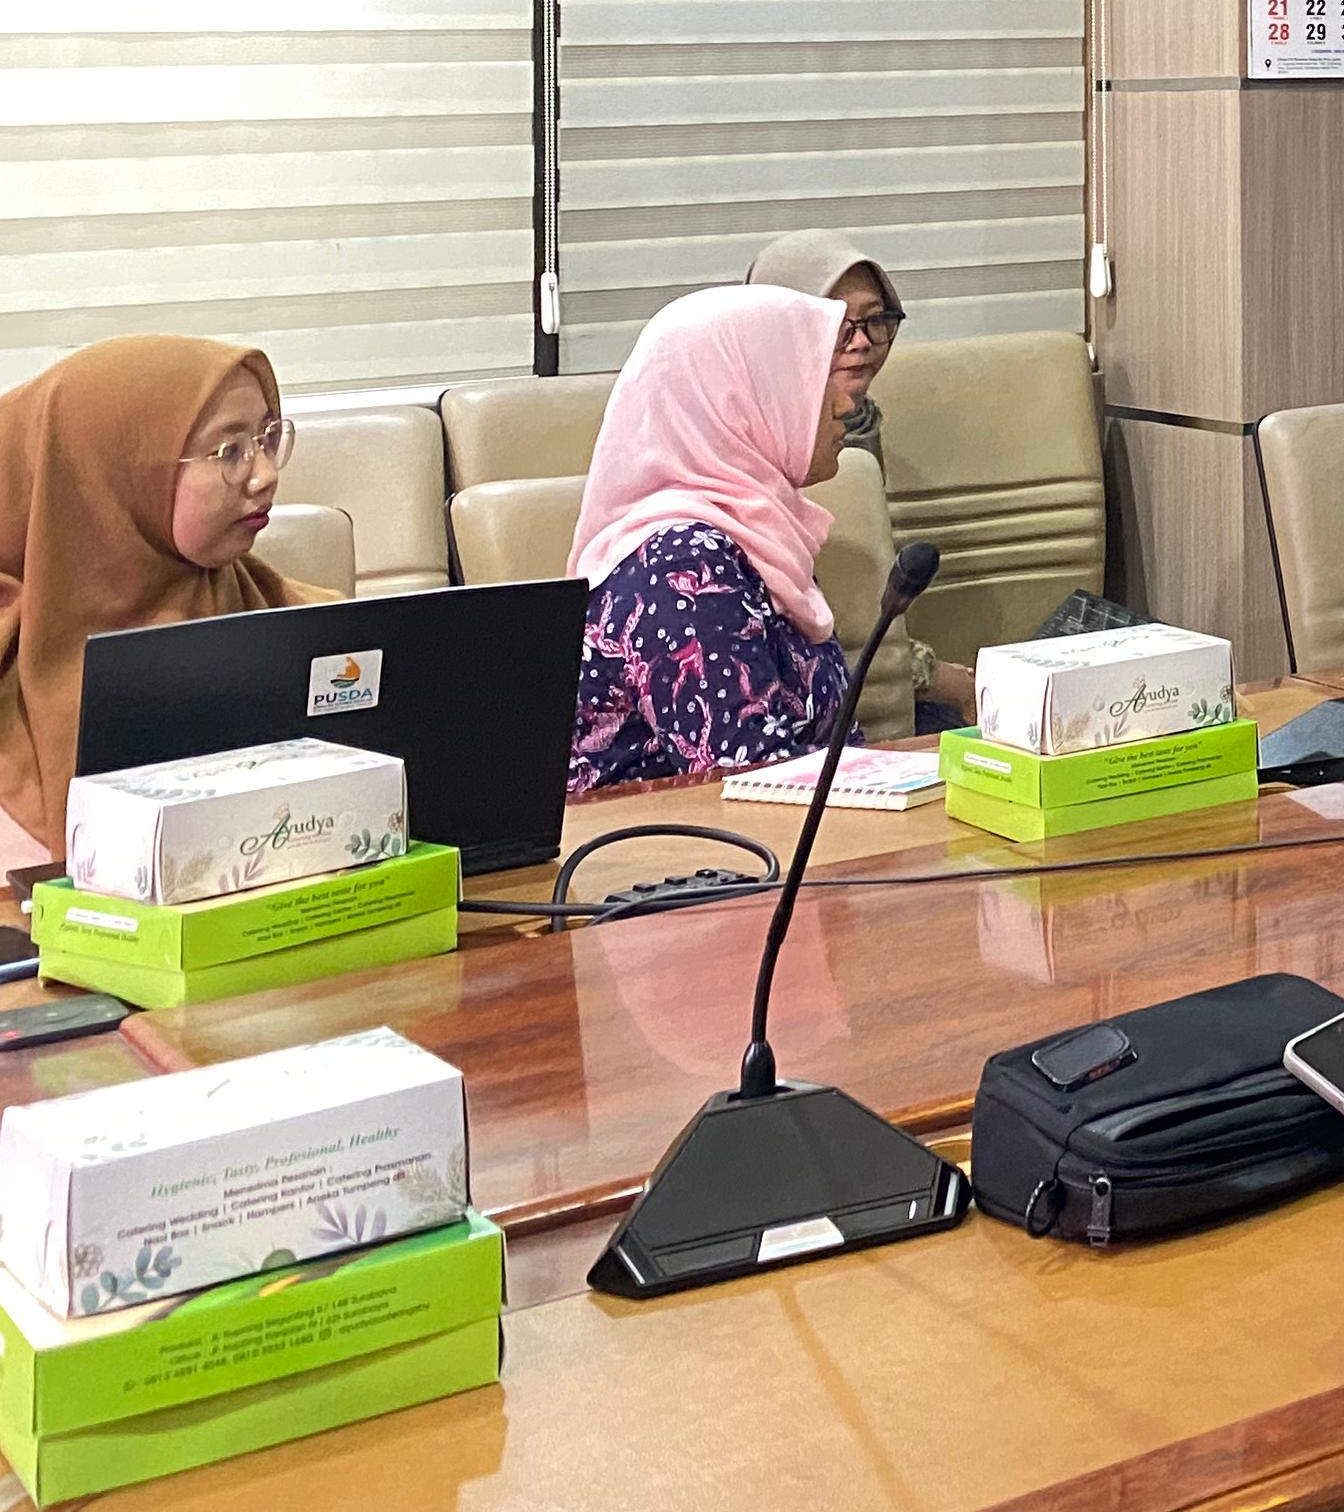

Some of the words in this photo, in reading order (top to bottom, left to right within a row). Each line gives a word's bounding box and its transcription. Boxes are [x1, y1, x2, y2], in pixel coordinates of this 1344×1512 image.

[1268, 0, 1287, 16] 21
[1305, 0, 1326, 16] 22
[1268, 23, 1290, 40] 28
[1305, 23, 1326, 41] 29
[313, 688, 373, 706] PUSDA
[1109, 683, 1180, 718] Ayudya
[240, 813, 334, 856] Ayudya
[223, 1163, 260, 1180] Tasty,
[349, 1125, 400, 1150] Healthy
[326, 1168, 373, 1187] Catering
